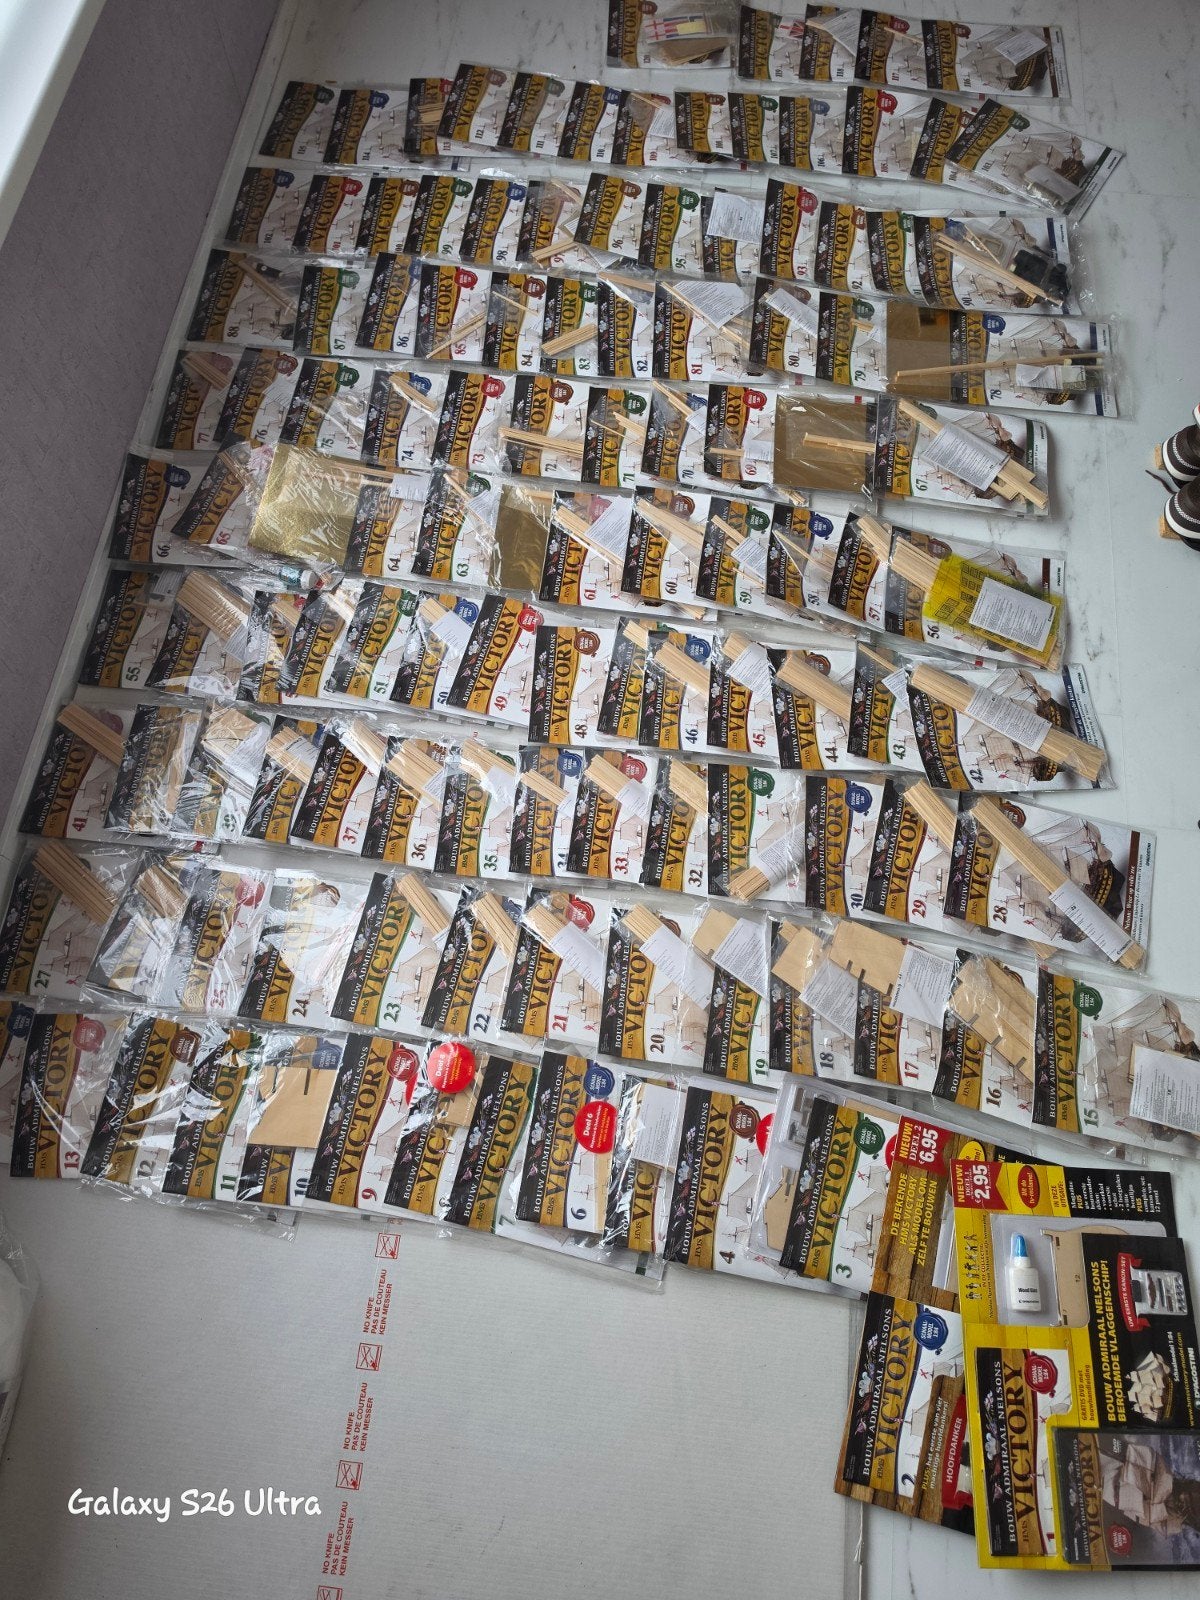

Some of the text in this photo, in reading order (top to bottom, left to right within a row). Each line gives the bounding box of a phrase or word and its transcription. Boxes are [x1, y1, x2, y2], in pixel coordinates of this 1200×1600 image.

[456, 70, 487, 128] VICTORY
[577, 88, 601, 149] VICTORY
[858, 94, 877, 171] VICTORY
[311, 182, 341, 246] VICTORY
[374, 182, 399, 247] VICTORY
[424, 182, 450, 247] VICTORY
[593, 178, 620, 239] VICTORY
[658, 192, 677, 256] VICTORY
[612, 238, 624, 249] 96
[778, 191, 799, 267] VICTORY
[833, 210, 852, 281] VICTORY
[496, 250, 509, 261] 98
[675, 258, 687, 269] 95
[209, 259, 239, 330] VICTORY
[315, 272, 336, 340] VICTORY
[333, 338, 345, 350] 87
[396, 335, 408, 348] 86
[520, 353, 533, 366] 84
[578, 357, 590, 371] 83
[636, 359, 648, 371] 82
[690, 363, 703, 375] 81
[788, 354, 800, 367] 80
[855, 370, 867, 382] 79
[990, 388, 1002, 400] 78
[452, 379, 480, 453] VICTORY
[401, 450, 414, 462] 74
[472, 453, 484, 465] 73
[545, 461, 557, 473] 72
[916, 479, 928, 491] 67
[134, 467, 161, 545] VICTORY
[388, 557, 400, 572] 64
[456, 563, 469, 577] 63
[584, 589, 596, 600] 61
[665, 581, 678, 594] 60
[740, 591, 752, 605] 59
[808, 592, 820, 605] 58
[489, 603, 503, 646] NELSONS
[868, 607, 880, 621] 57
[474, 605, 518, 694] VICTORY
[927, 625, 940, 639] 56
[126, 667, 140, 682] 55
[552, 635, 572, 725] VICTORY
[494, 696, 508, 711] 49
[575, 724, 588, 738] 48
[685, 729, 698, 744] 46
[753, 734, 766, 747] 45
[826, 745, 838, 762] 44
[892, 743, 905, 760] 43
[970, 770, 982, 783] 42
[343, 827, 358, 844] 37
[411, 843, 427, 860] 36
[827, 784, 845, 899] VICTORY
[483, 855, 497, 872] 35
[615, 857, 628, 875] 33
[688, 869, 703, 887] 32
[851, 893, 863, 909] 30
[913, 900, 927, 919] 29
[993, 905, 1008, 924] 28
[384, 1002, 401, 1022] 23
[1053, 986, 1076, 1105] VICTORY
[38, 1027, 72, 1154] VICTORY
[325, 1046, 369, 1192] BOUW ADMIRAAL NELSONS
[338, 1047, 387, 1178] VICTORY
[463, 1070, 508, 1218] BOUW ADMIRAAL NELSONS
[479, 1075, 529, 1202] VICTORY
[534, 1066, 563, 1214] BOUW ADMIRAAL NELSONS
[545, 1068, 582, 1197] VICTORY
[899, 1122, 913, 1159] NIEUW!
[909, 1133, 920, 1160] DEEL
[918, 1128, 938, 1164] €6,95
[64, 1150, 80, 1169] 13
[182, 1151, 195, 1185] BOUW
[694, 1104, 728, 1239] VICTORY
[361, 1188, 377, 1201] 9
[403, 1166, 417, 1199] BOUW
[682, 1102, 709, 1255] BOUW ADMIRAAL NELSONS
[799, 1114, 835, 1264] BOUW ADMIRAAL NELSONS
[811, 1120, 853, 1250] VICTORY
[895, 1172, 908, 1219] BEKENDE
[955, 1164, 965, 1202] NIEUW!
[974, 1165, 991, 1203] €2,95
[1058, 1181, 1067, 1207] UITGAVE:
[1068, 1180, 1077, 1208] Magazine
[570, 1207, 586, 1220] 6
[906, 1175, 919, 1219] VICTORY
[908, 1177, 927, 1255] ALS MODEL OM
[917, 1180, 938, 1266] ZELF BOUWEN
[719, 1250, 735, 1264] 4
[835, 1263, 853, 1278] 3
[376, 1269, 387, 1304] COUTEAU
[382, 1283, 392, 1312] MESSER
[363, 1297, 374, 1333] NO KNIFE
[374, 1307, 380, 1317] DE
[1101, 1260, 1119, 1351] VLAGGENSCHIP!
[1091, 1262, 1117, 1421] BOUW ADMIRAAL NELSONS
[862, 1308, 892, 1476] BOUW ADMIRAAL NELSONS
[875, 1312, 912, 1459] VICTORY
[1109, 1354, 1127, 1422] BEROEMDE
[351, 1382, 367, 1451] PAS DE COUTEAU
[363, 1397, 373, 1427] MESSER
[936, 1400, 949, 1451] hoofdankers!
[343, 1412, 354, 1450] NO KNIFE
[1003, 1362, 1035, 1522] VICTORY
[946, 1417, 962, 1483] HOOFDANKER
[993, 1361, 1016, 1542] BOUW ADMIRAAL NELSONS
[1078, 1441, 1101, 1544] VICTORY
[322, 1532, 334, 1574] NO KNIFE
[331, 1501, 348, 1575] PAS DE COUTEAU
[339, 1517, 354, 1576] KEIN MESSER
